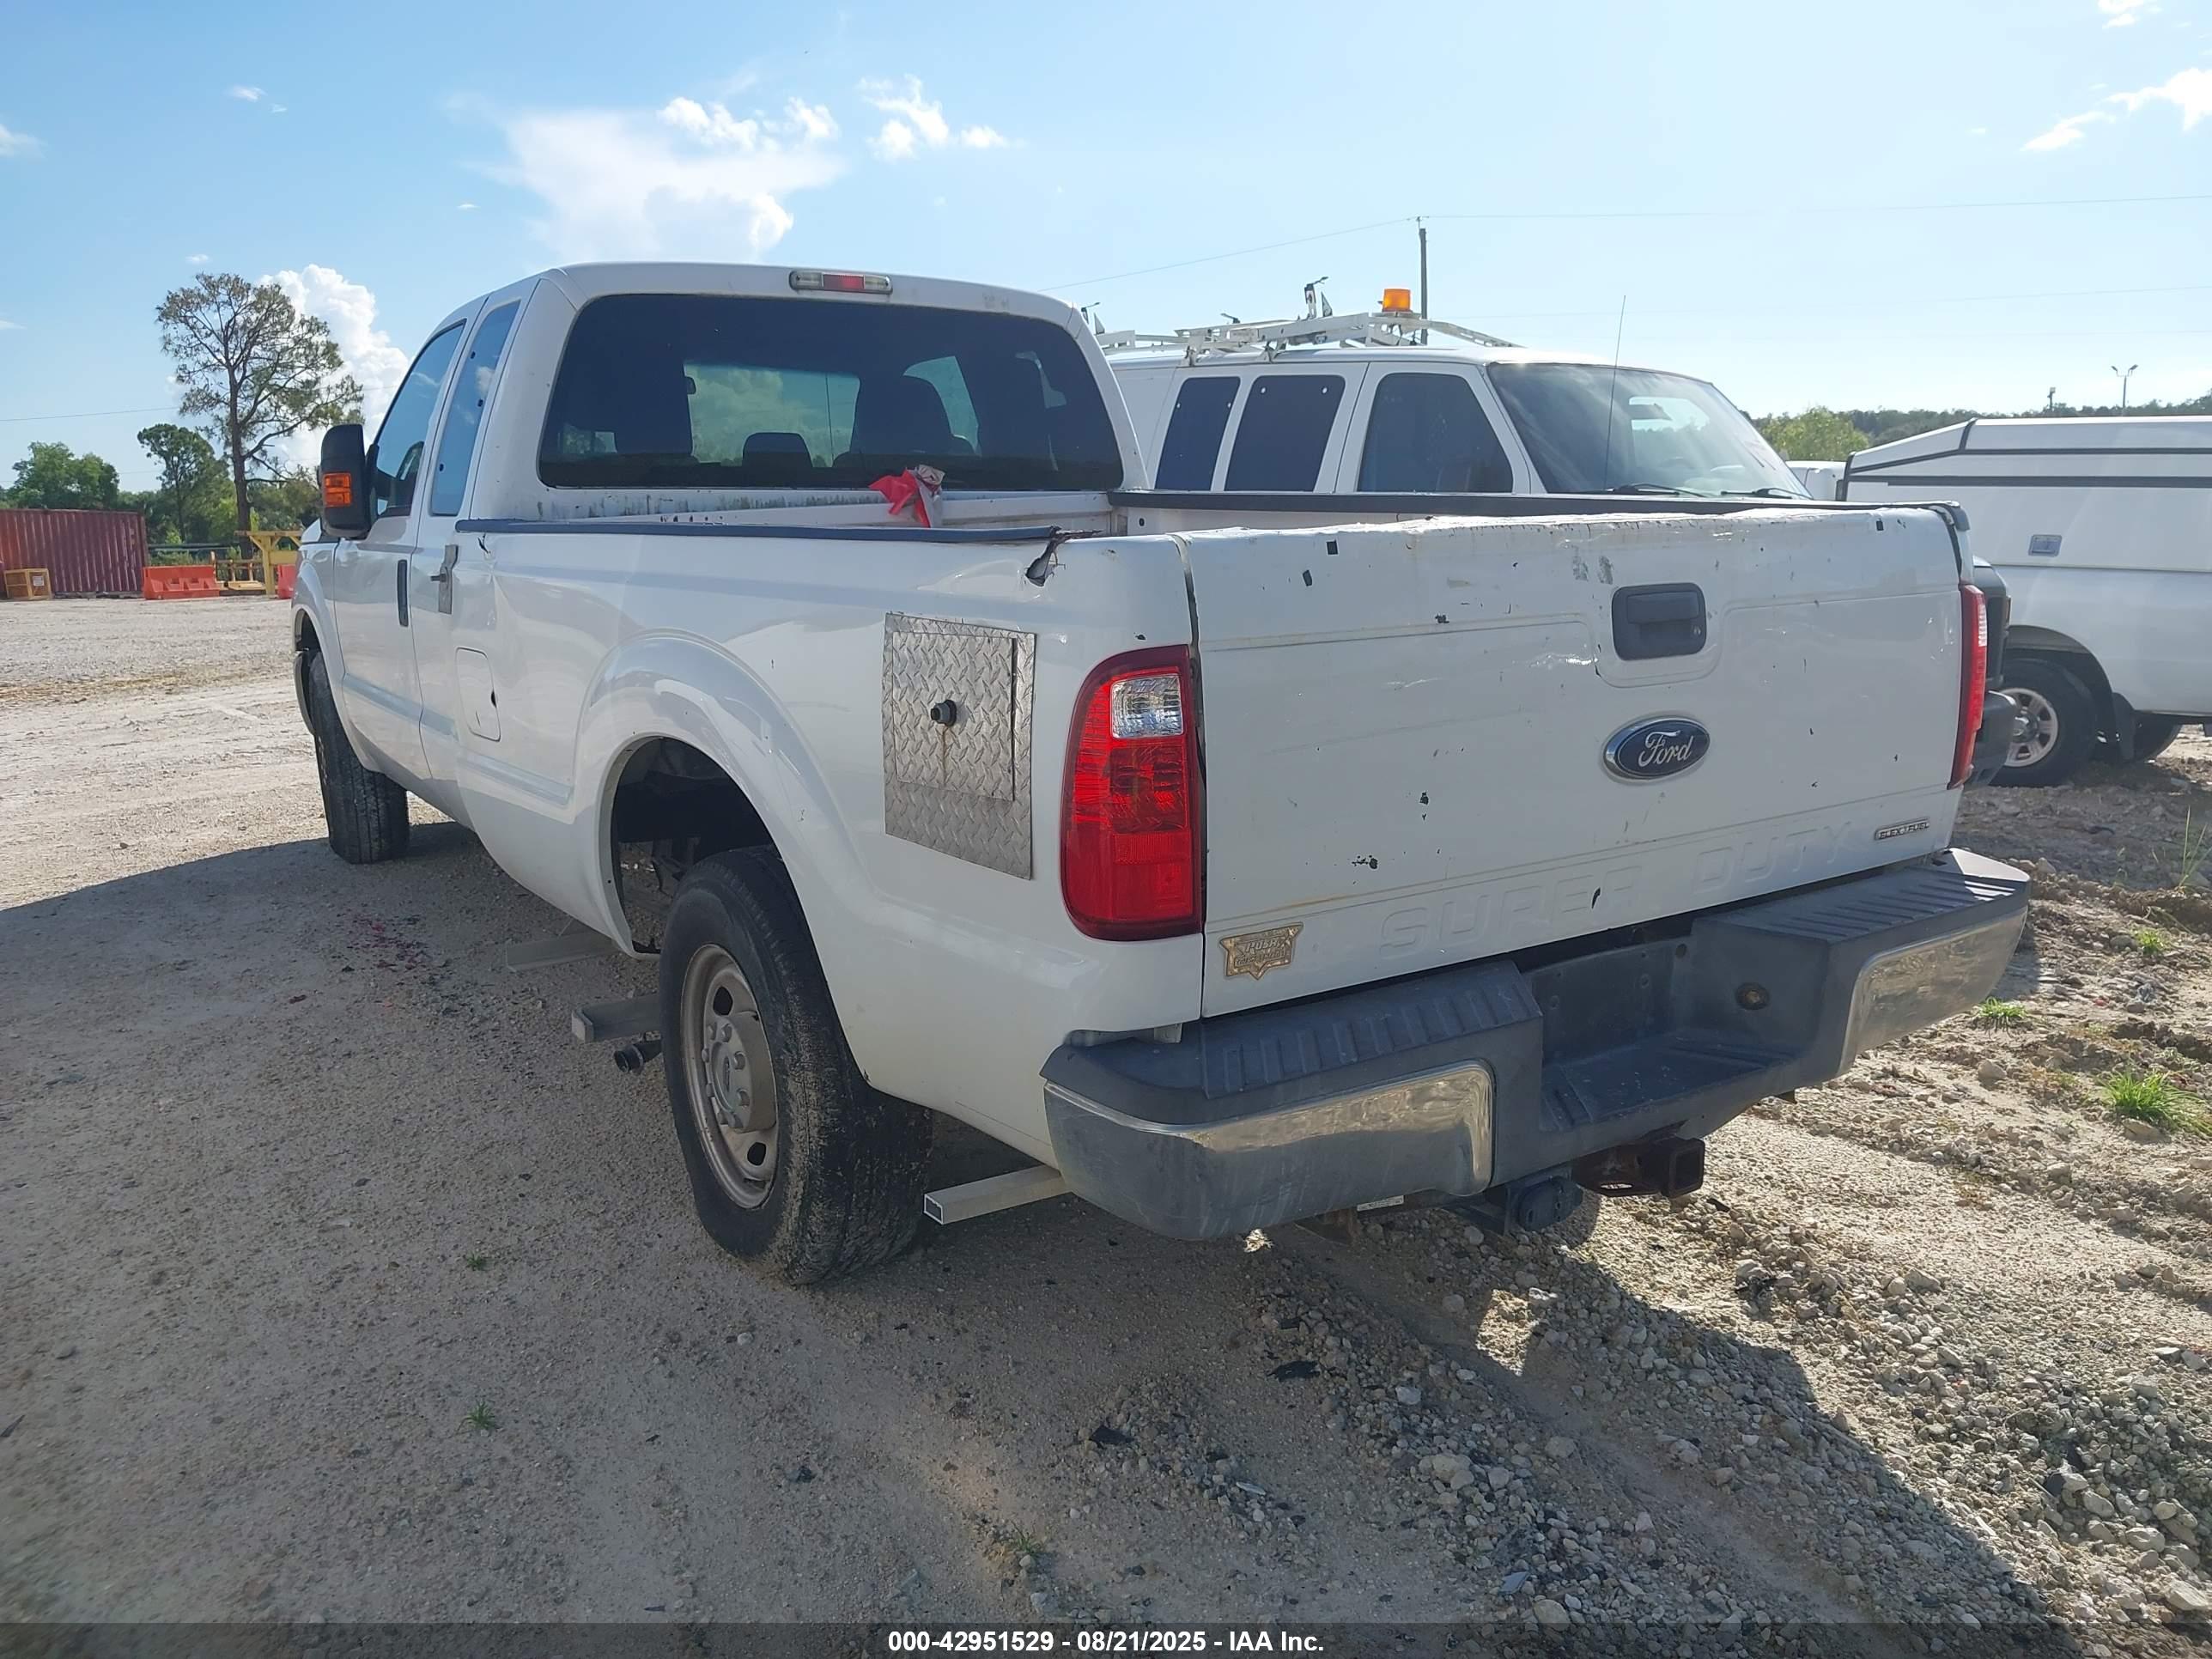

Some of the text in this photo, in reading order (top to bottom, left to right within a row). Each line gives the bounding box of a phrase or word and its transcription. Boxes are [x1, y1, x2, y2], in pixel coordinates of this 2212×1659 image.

[1638, 729, 1694, 767] Ford
[1378, 820, 1853, 960] SUPER DUTY
